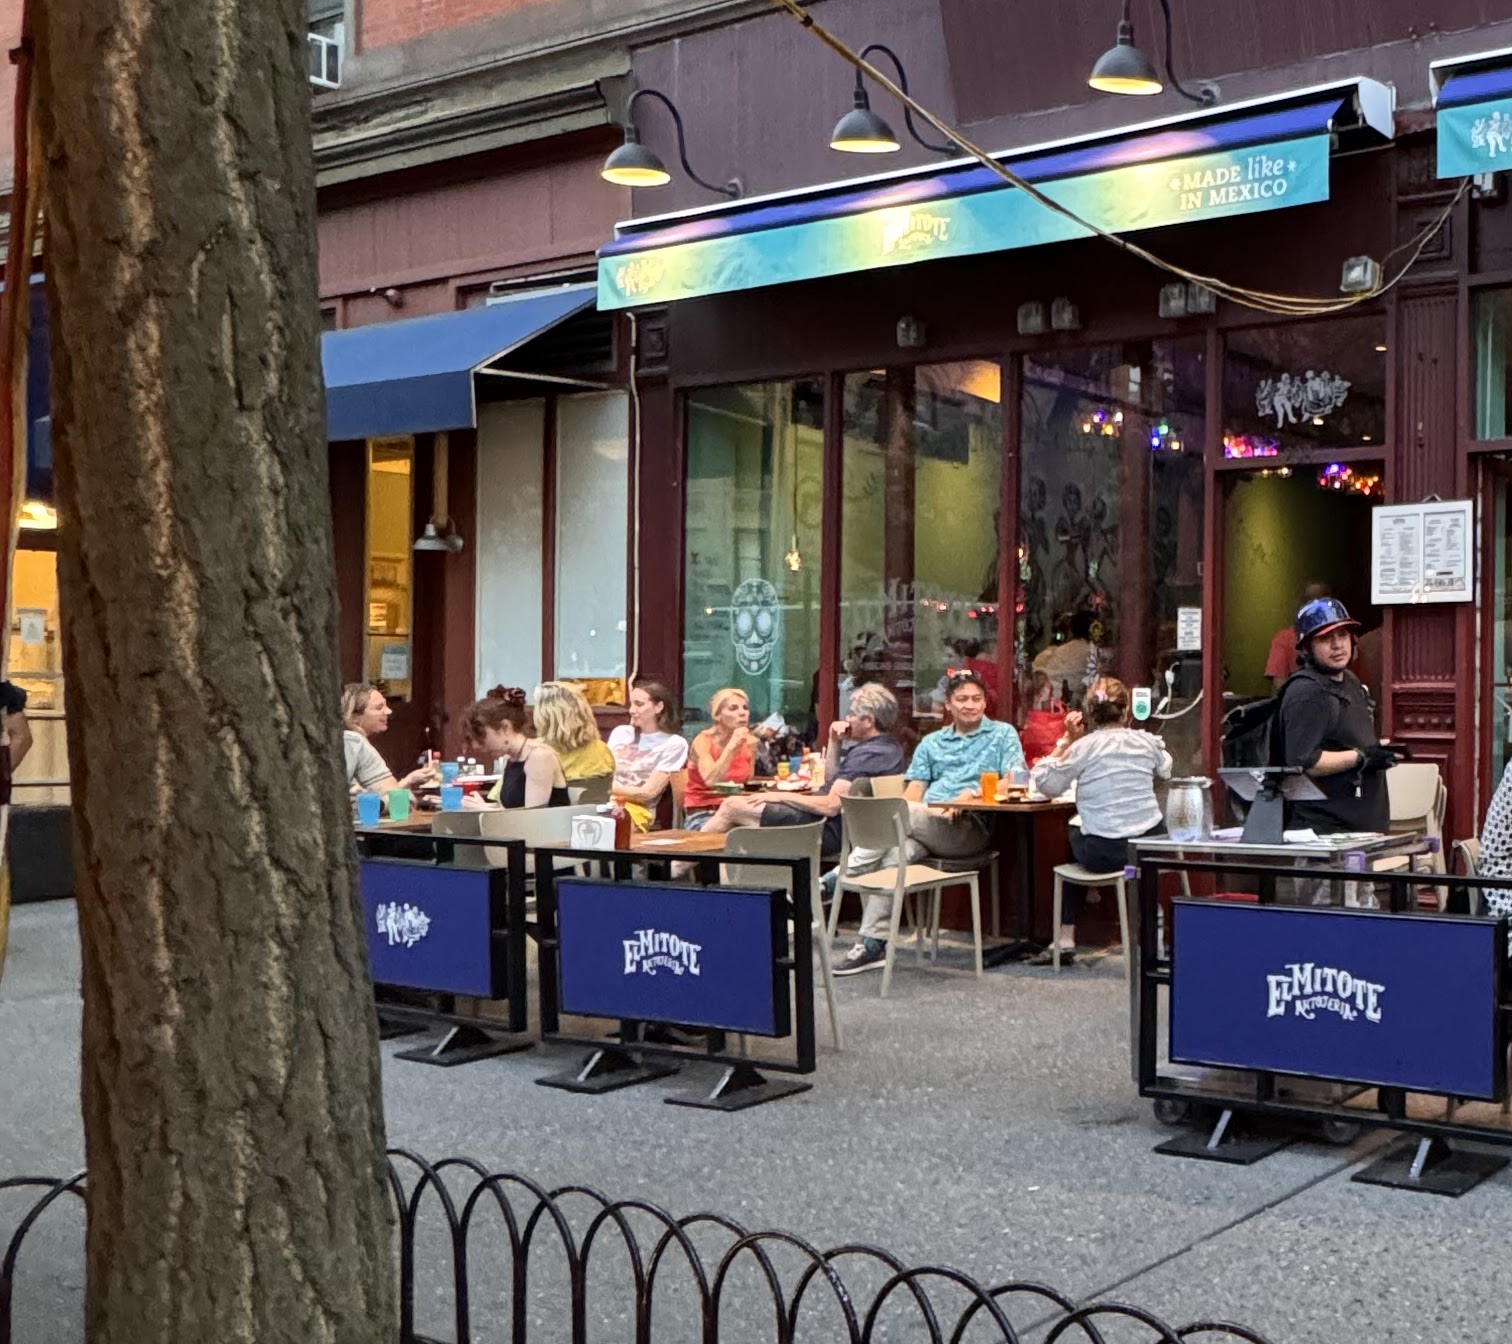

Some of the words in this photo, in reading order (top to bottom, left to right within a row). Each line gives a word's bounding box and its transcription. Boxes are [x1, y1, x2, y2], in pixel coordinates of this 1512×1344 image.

[1182, 165, 1241, 191] MADE
[1247, 155, 1284, 181] like
[1180, 191, 1203, 210] IN
[1208, 178, 1288, 206] MEXICO
